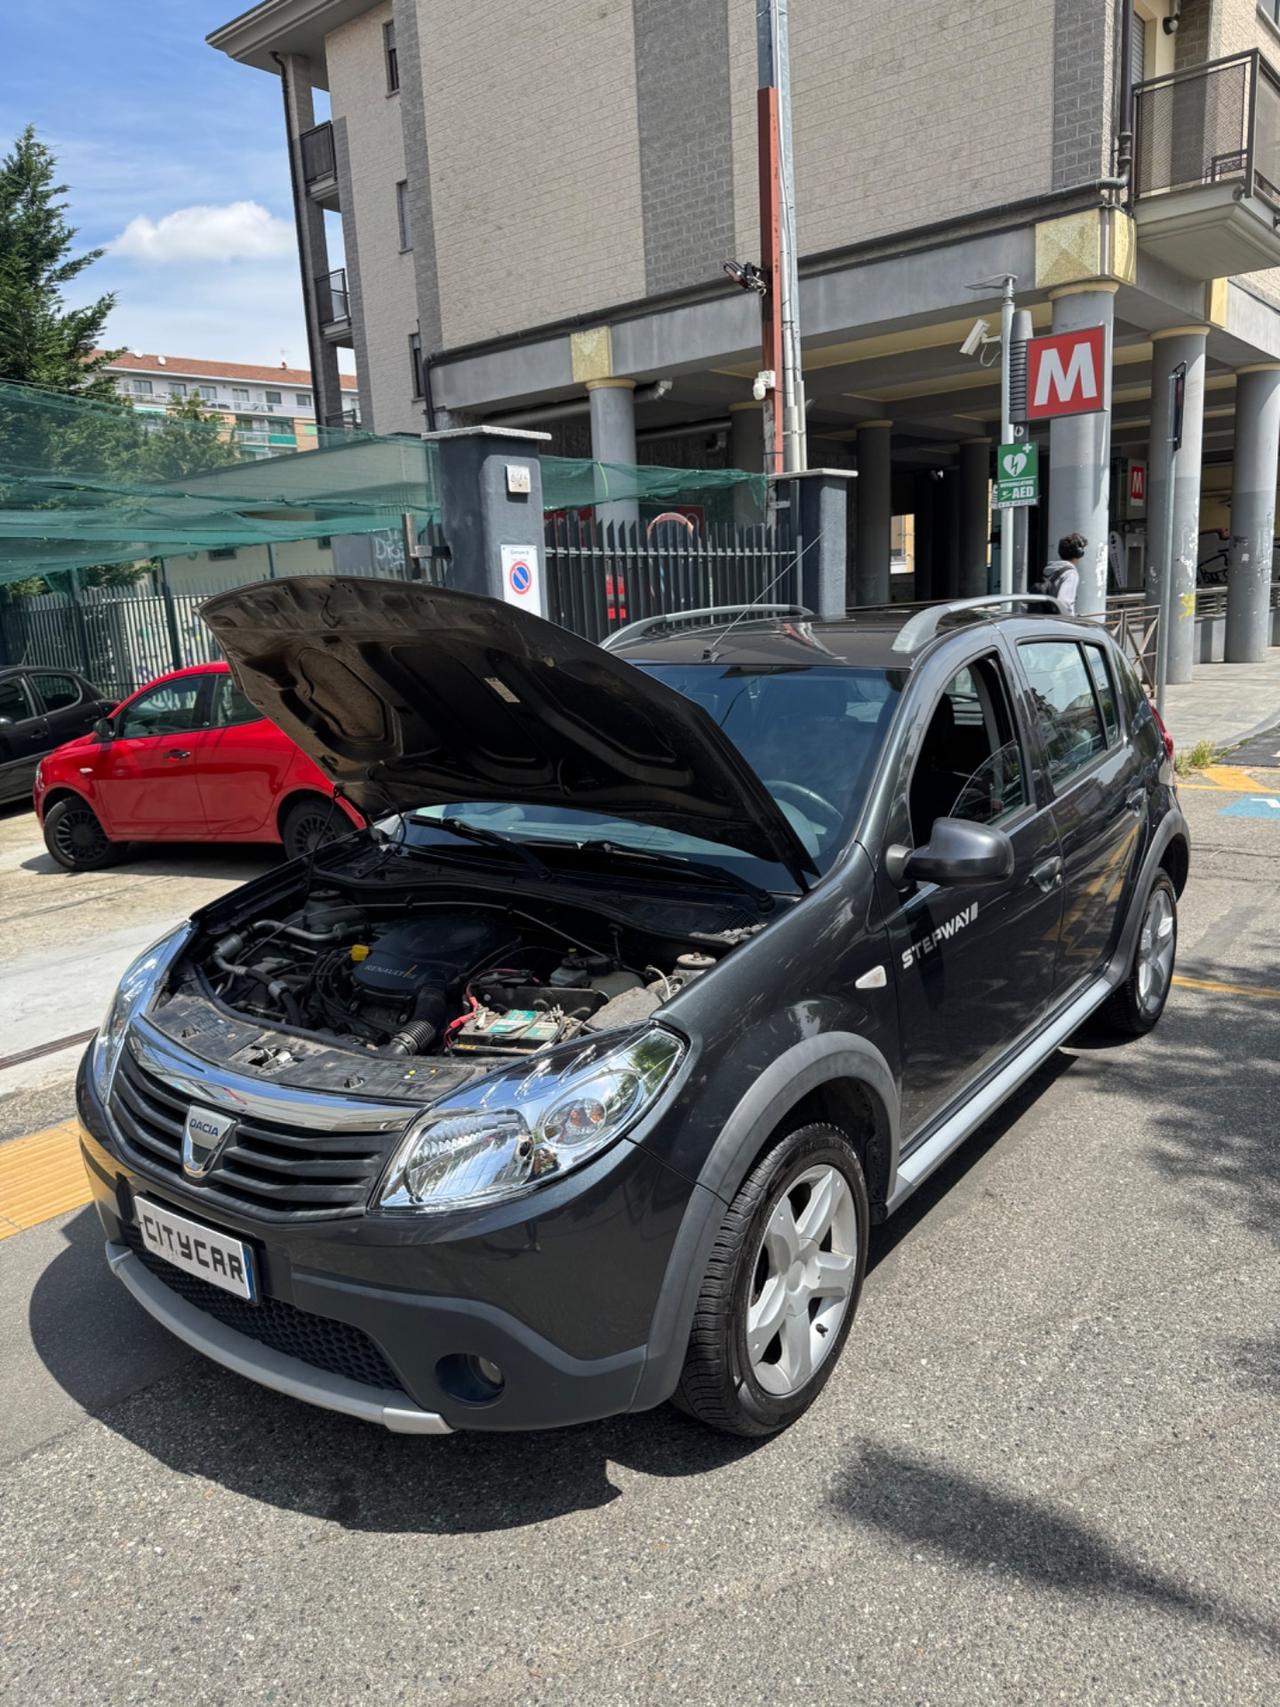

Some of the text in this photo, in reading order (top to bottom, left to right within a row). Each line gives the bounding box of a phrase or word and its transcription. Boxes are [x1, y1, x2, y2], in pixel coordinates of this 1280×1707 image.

[1033, 342, 1097, 406] M
[1012, 486, 1034, 499] AED
[1132, 471, 1143, 493] M
[901, 907, 969, 969] STEPWAY
[190, 1118, 219, 1137] DACIA
[143, 1214, 245, 1284] CITYCAR
